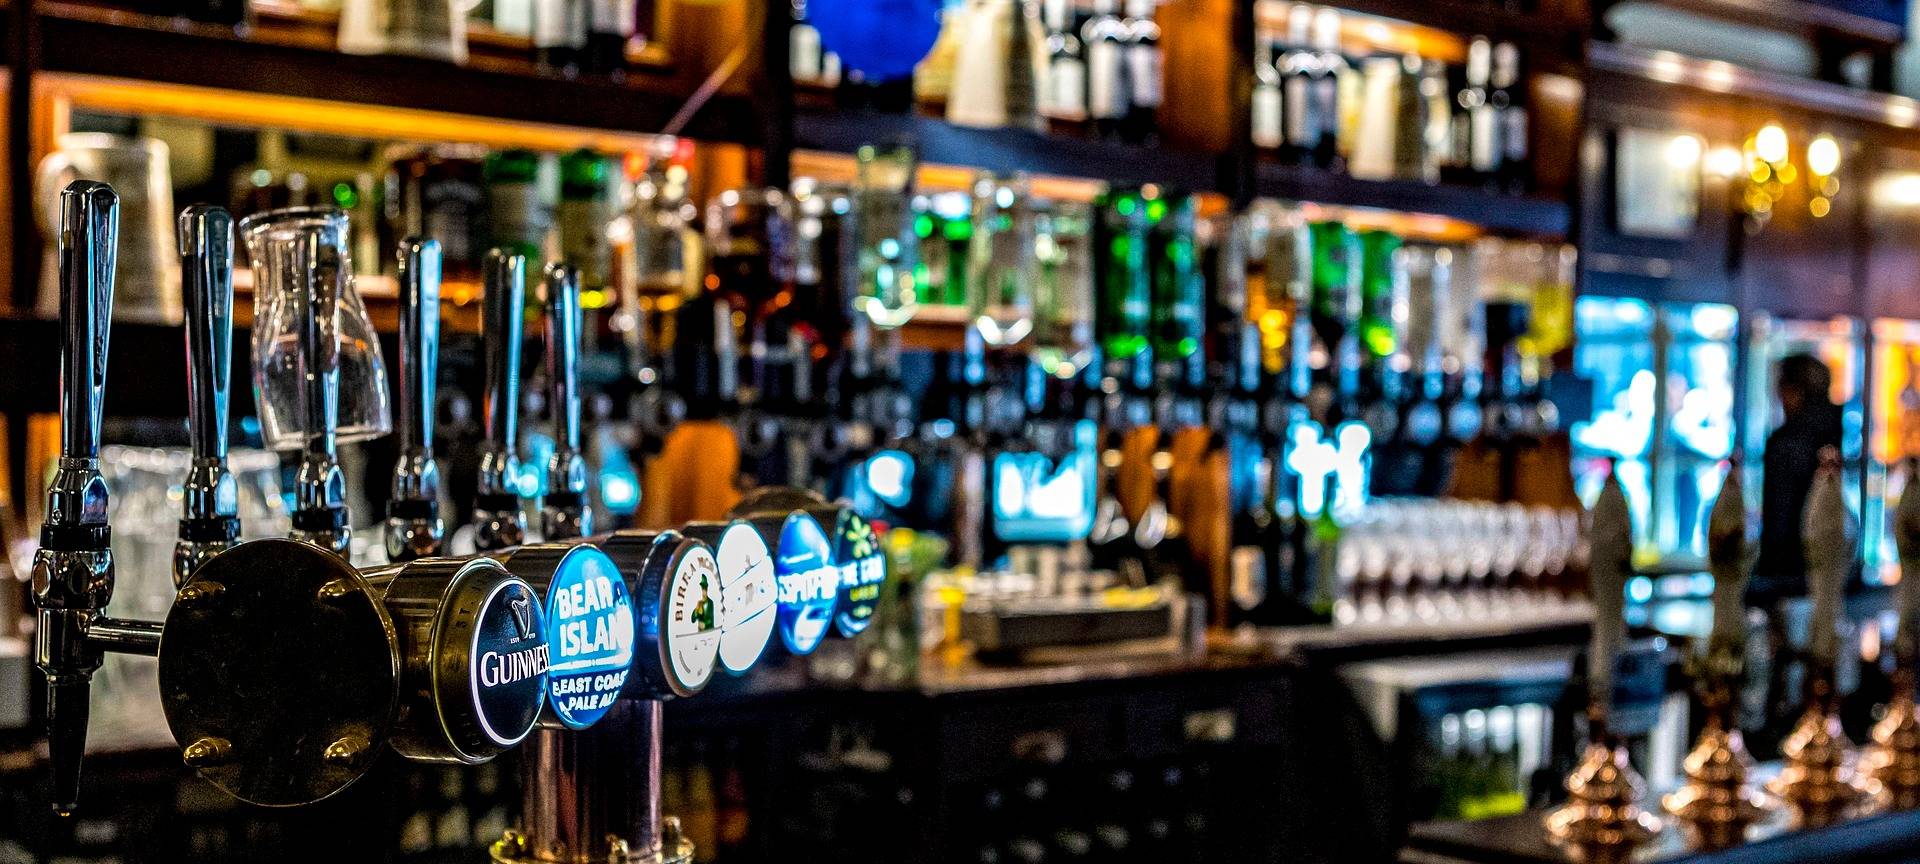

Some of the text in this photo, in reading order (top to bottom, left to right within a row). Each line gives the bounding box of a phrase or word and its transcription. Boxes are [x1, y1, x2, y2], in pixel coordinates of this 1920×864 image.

[558, 576, 613, 619] BEAR
[675, 563, 697, 622] BIRRA
[560, 611, 633, 657] ISLAN
[594, 669, 629, 691] COAS
[569, 694, 599, 711] PALE
